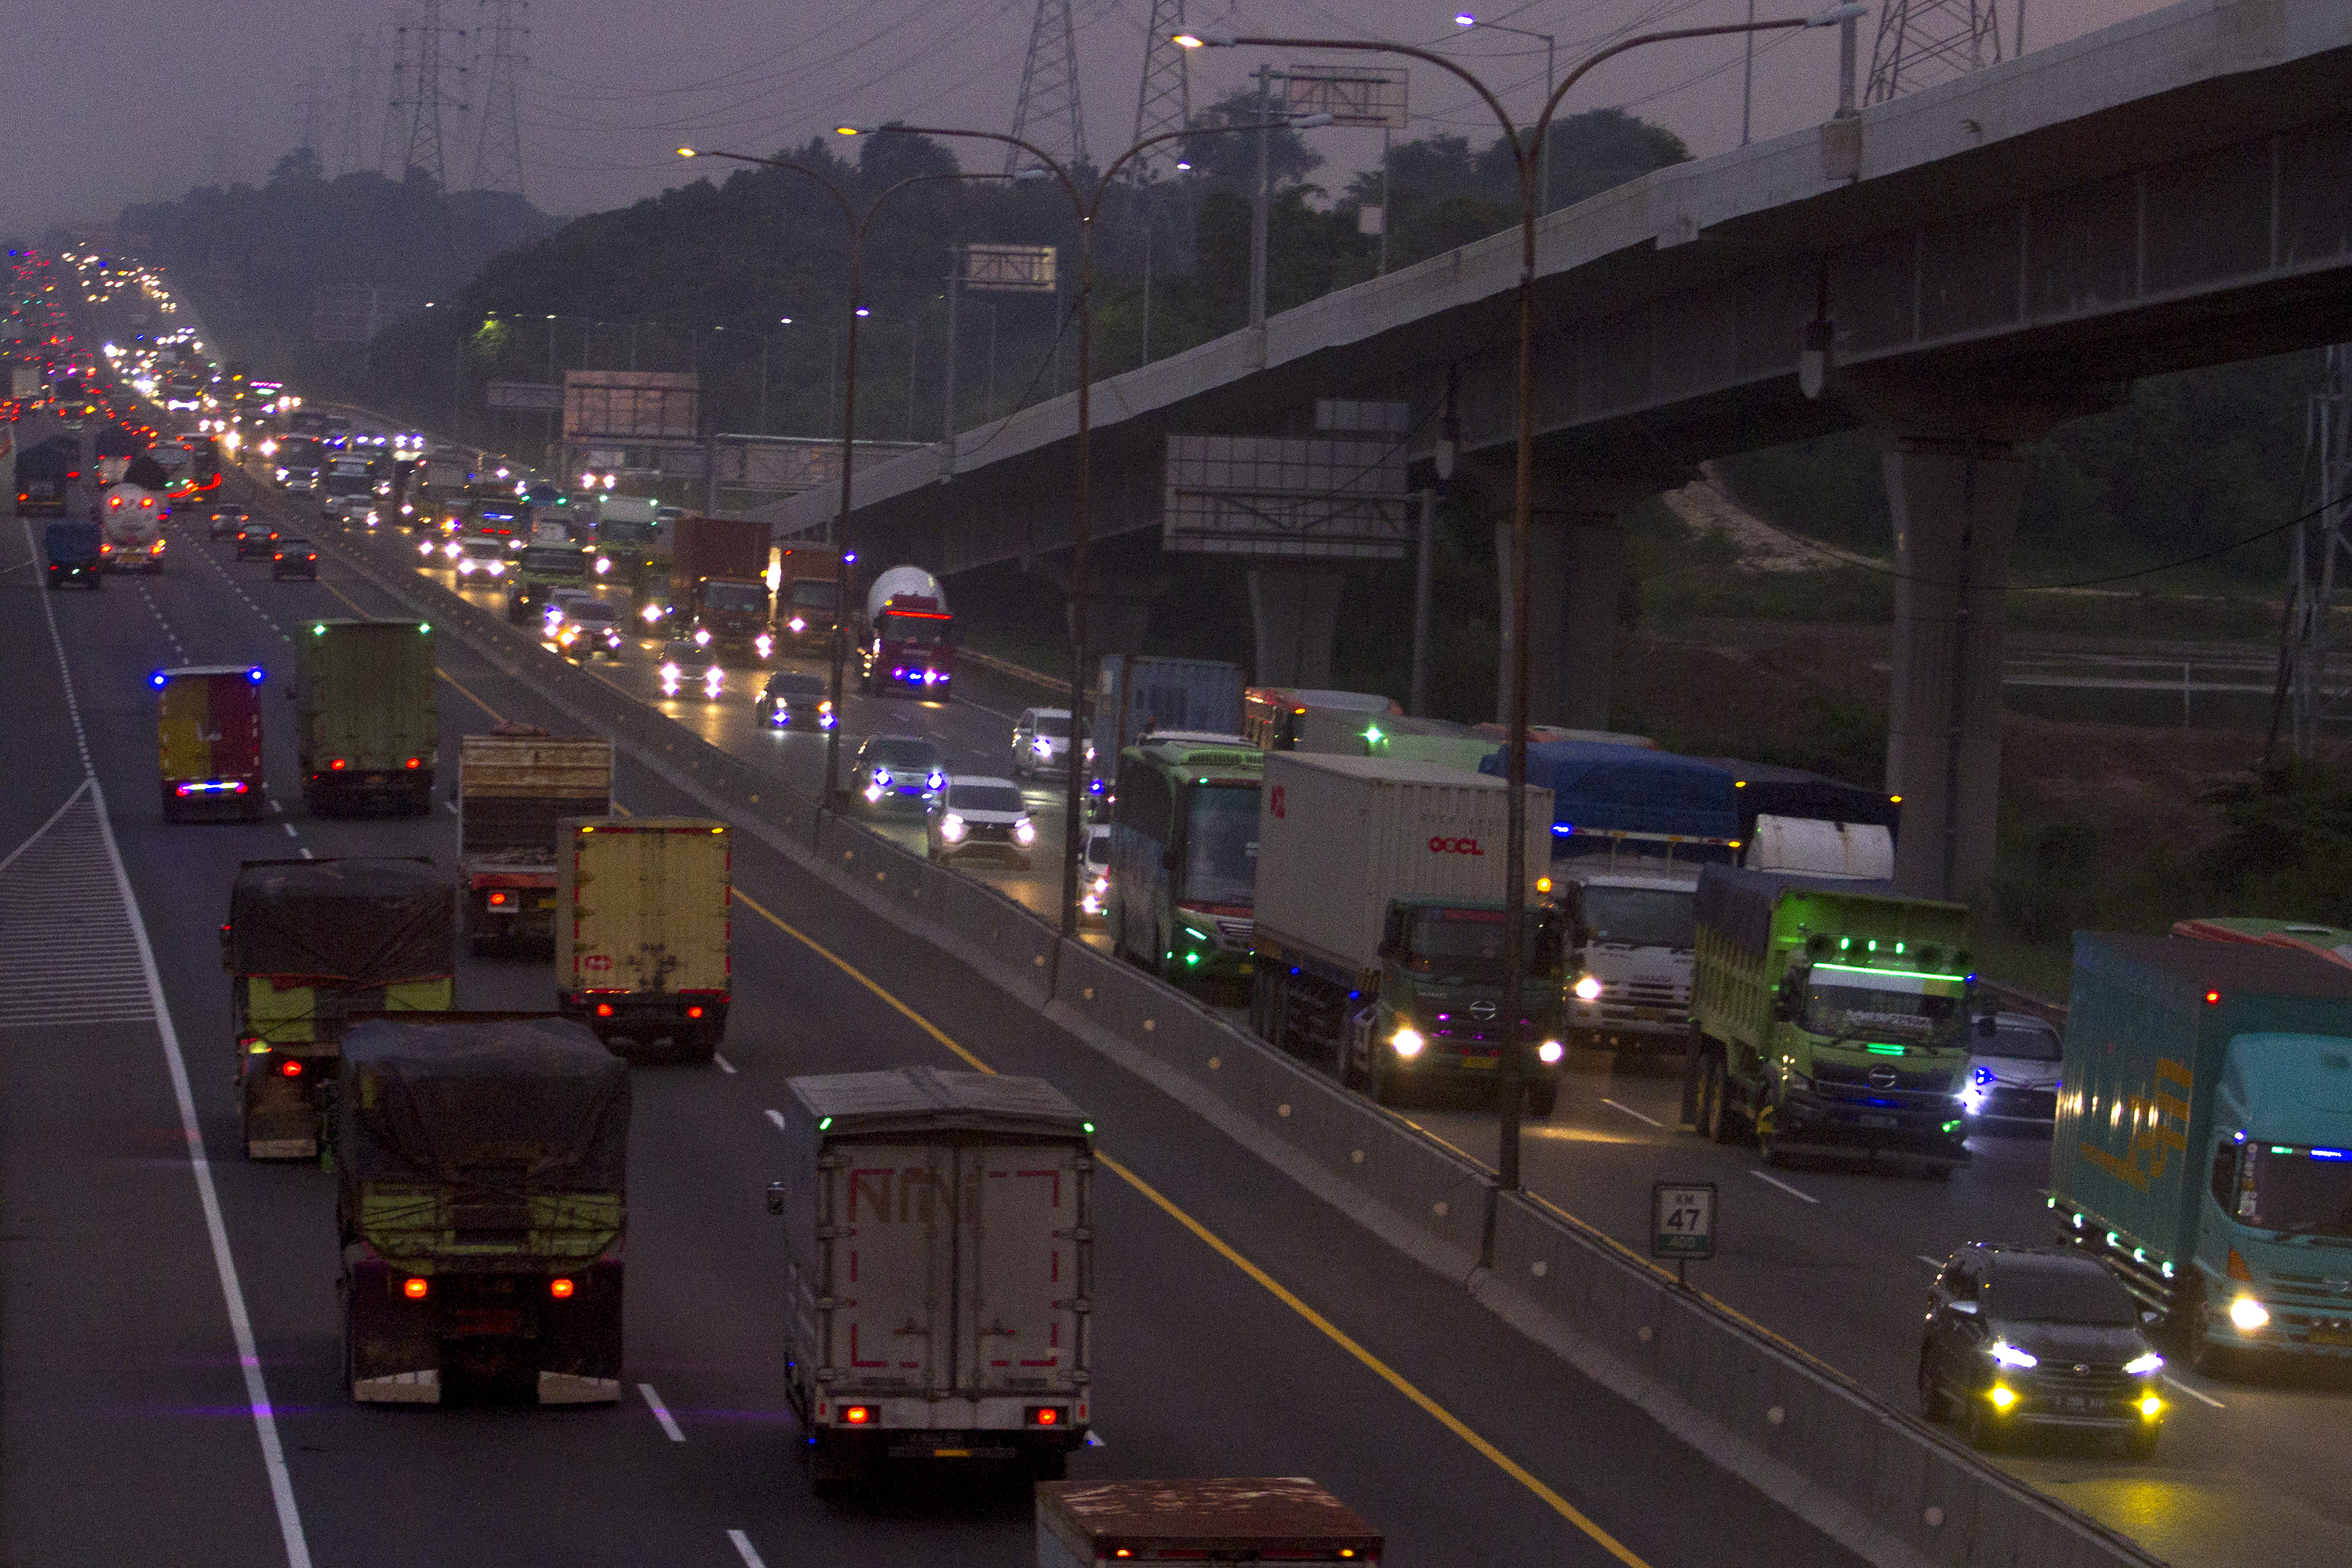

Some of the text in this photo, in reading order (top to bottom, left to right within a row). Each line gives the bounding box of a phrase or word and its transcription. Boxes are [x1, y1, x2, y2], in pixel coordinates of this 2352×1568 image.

[1429, 837, 1484, 855] OOCL
[1676, 1194, 1694, 1204] KM
[1668, 1209, 1700, 1231] 47
